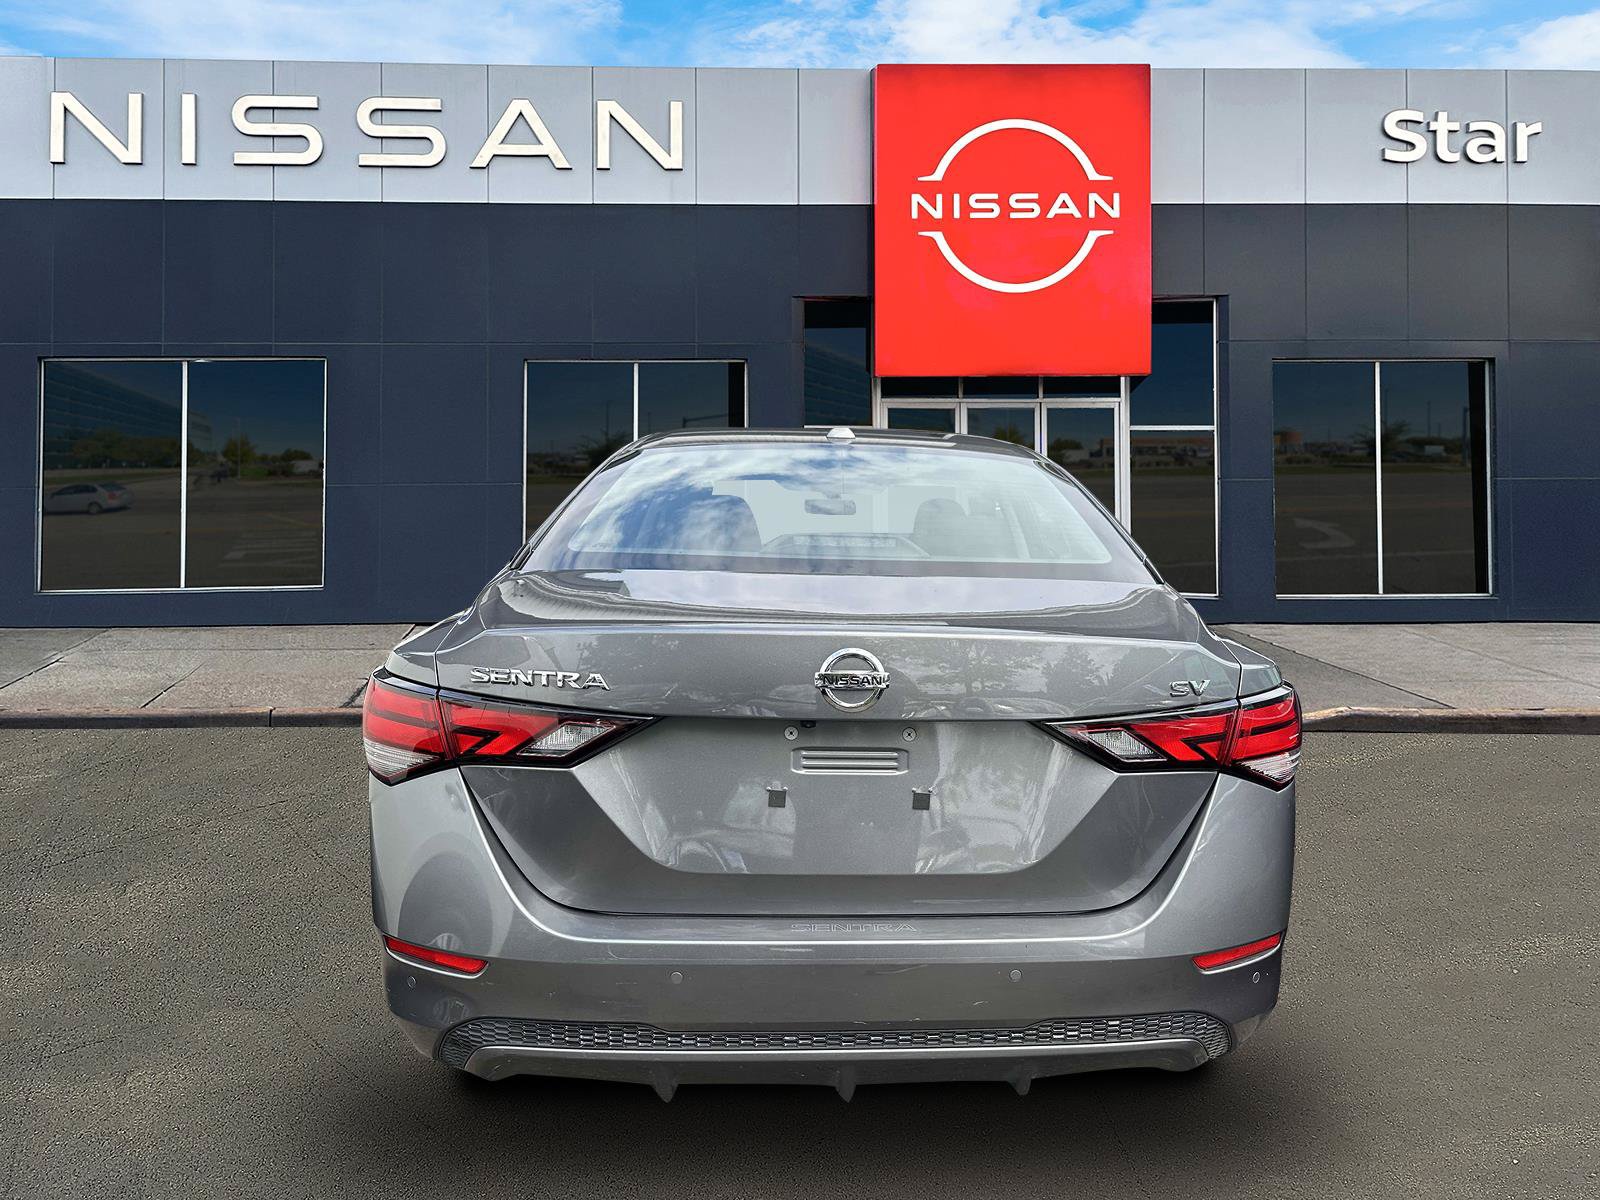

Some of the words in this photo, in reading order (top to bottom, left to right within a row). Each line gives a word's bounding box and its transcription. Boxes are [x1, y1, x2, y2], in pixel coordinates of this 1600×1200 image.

[50, 91, 684, 171] NISSAN
[1382, 109, 1543, 164] Star
[911, 192, 1121, 220] NISSAN
[470, 666, 610, 691] SENTRA
[823, 675, 882, 686] NISSAN
[1169, 679, 1211, 697] SV
[791, 922, 918, 933] SENTRA
